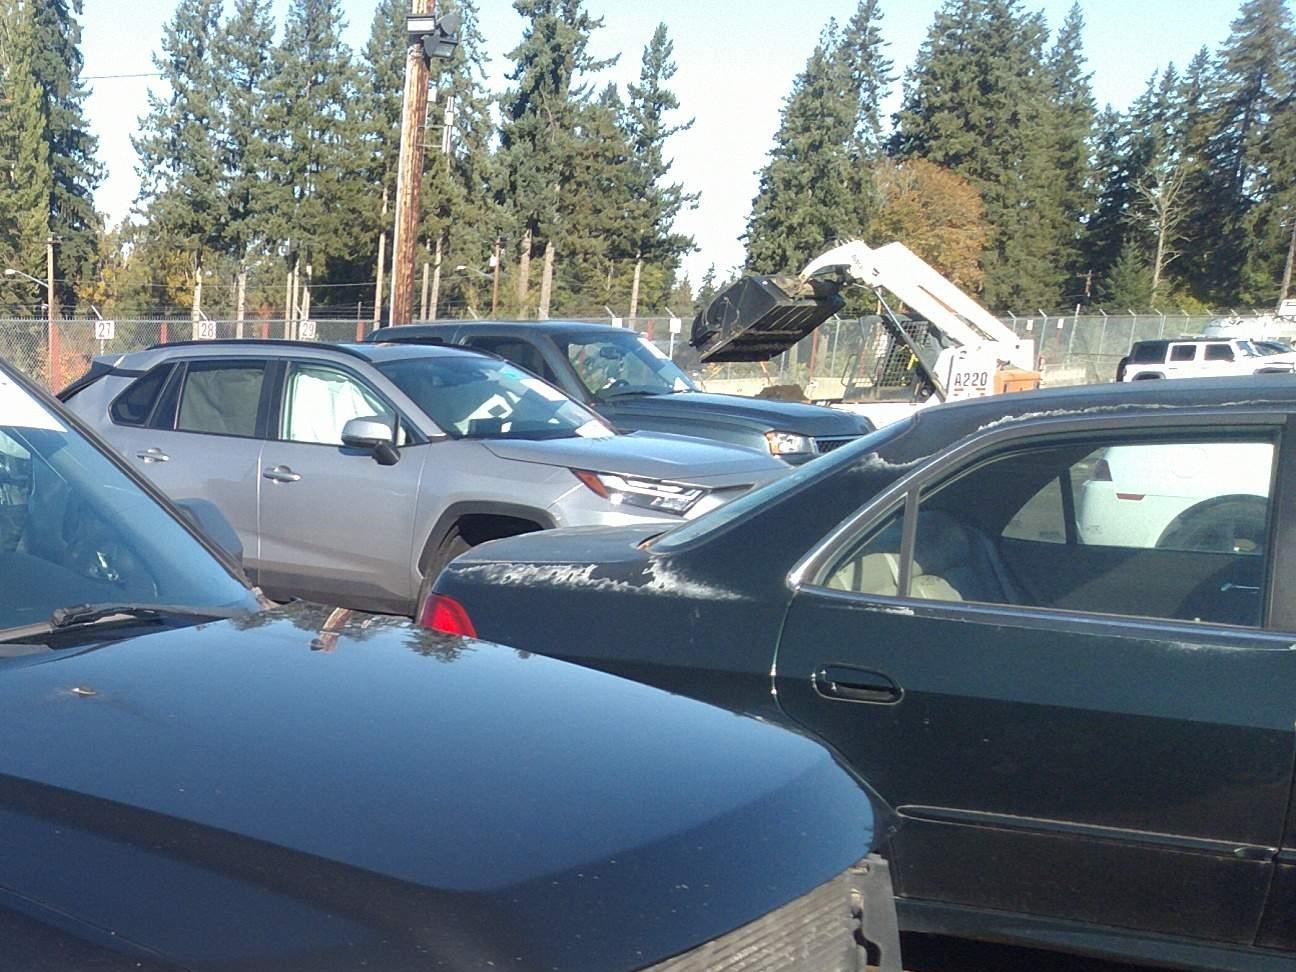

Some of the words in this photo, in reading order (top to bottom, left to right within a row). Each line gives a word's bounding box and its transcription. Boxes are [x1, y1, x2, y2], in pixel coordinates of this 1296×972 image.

[98, 322, 111, 338] 27
[201, 322, 214, 338] 28
[302, 322, 315, 337] 29
[953, 371, 988, 387] A220
